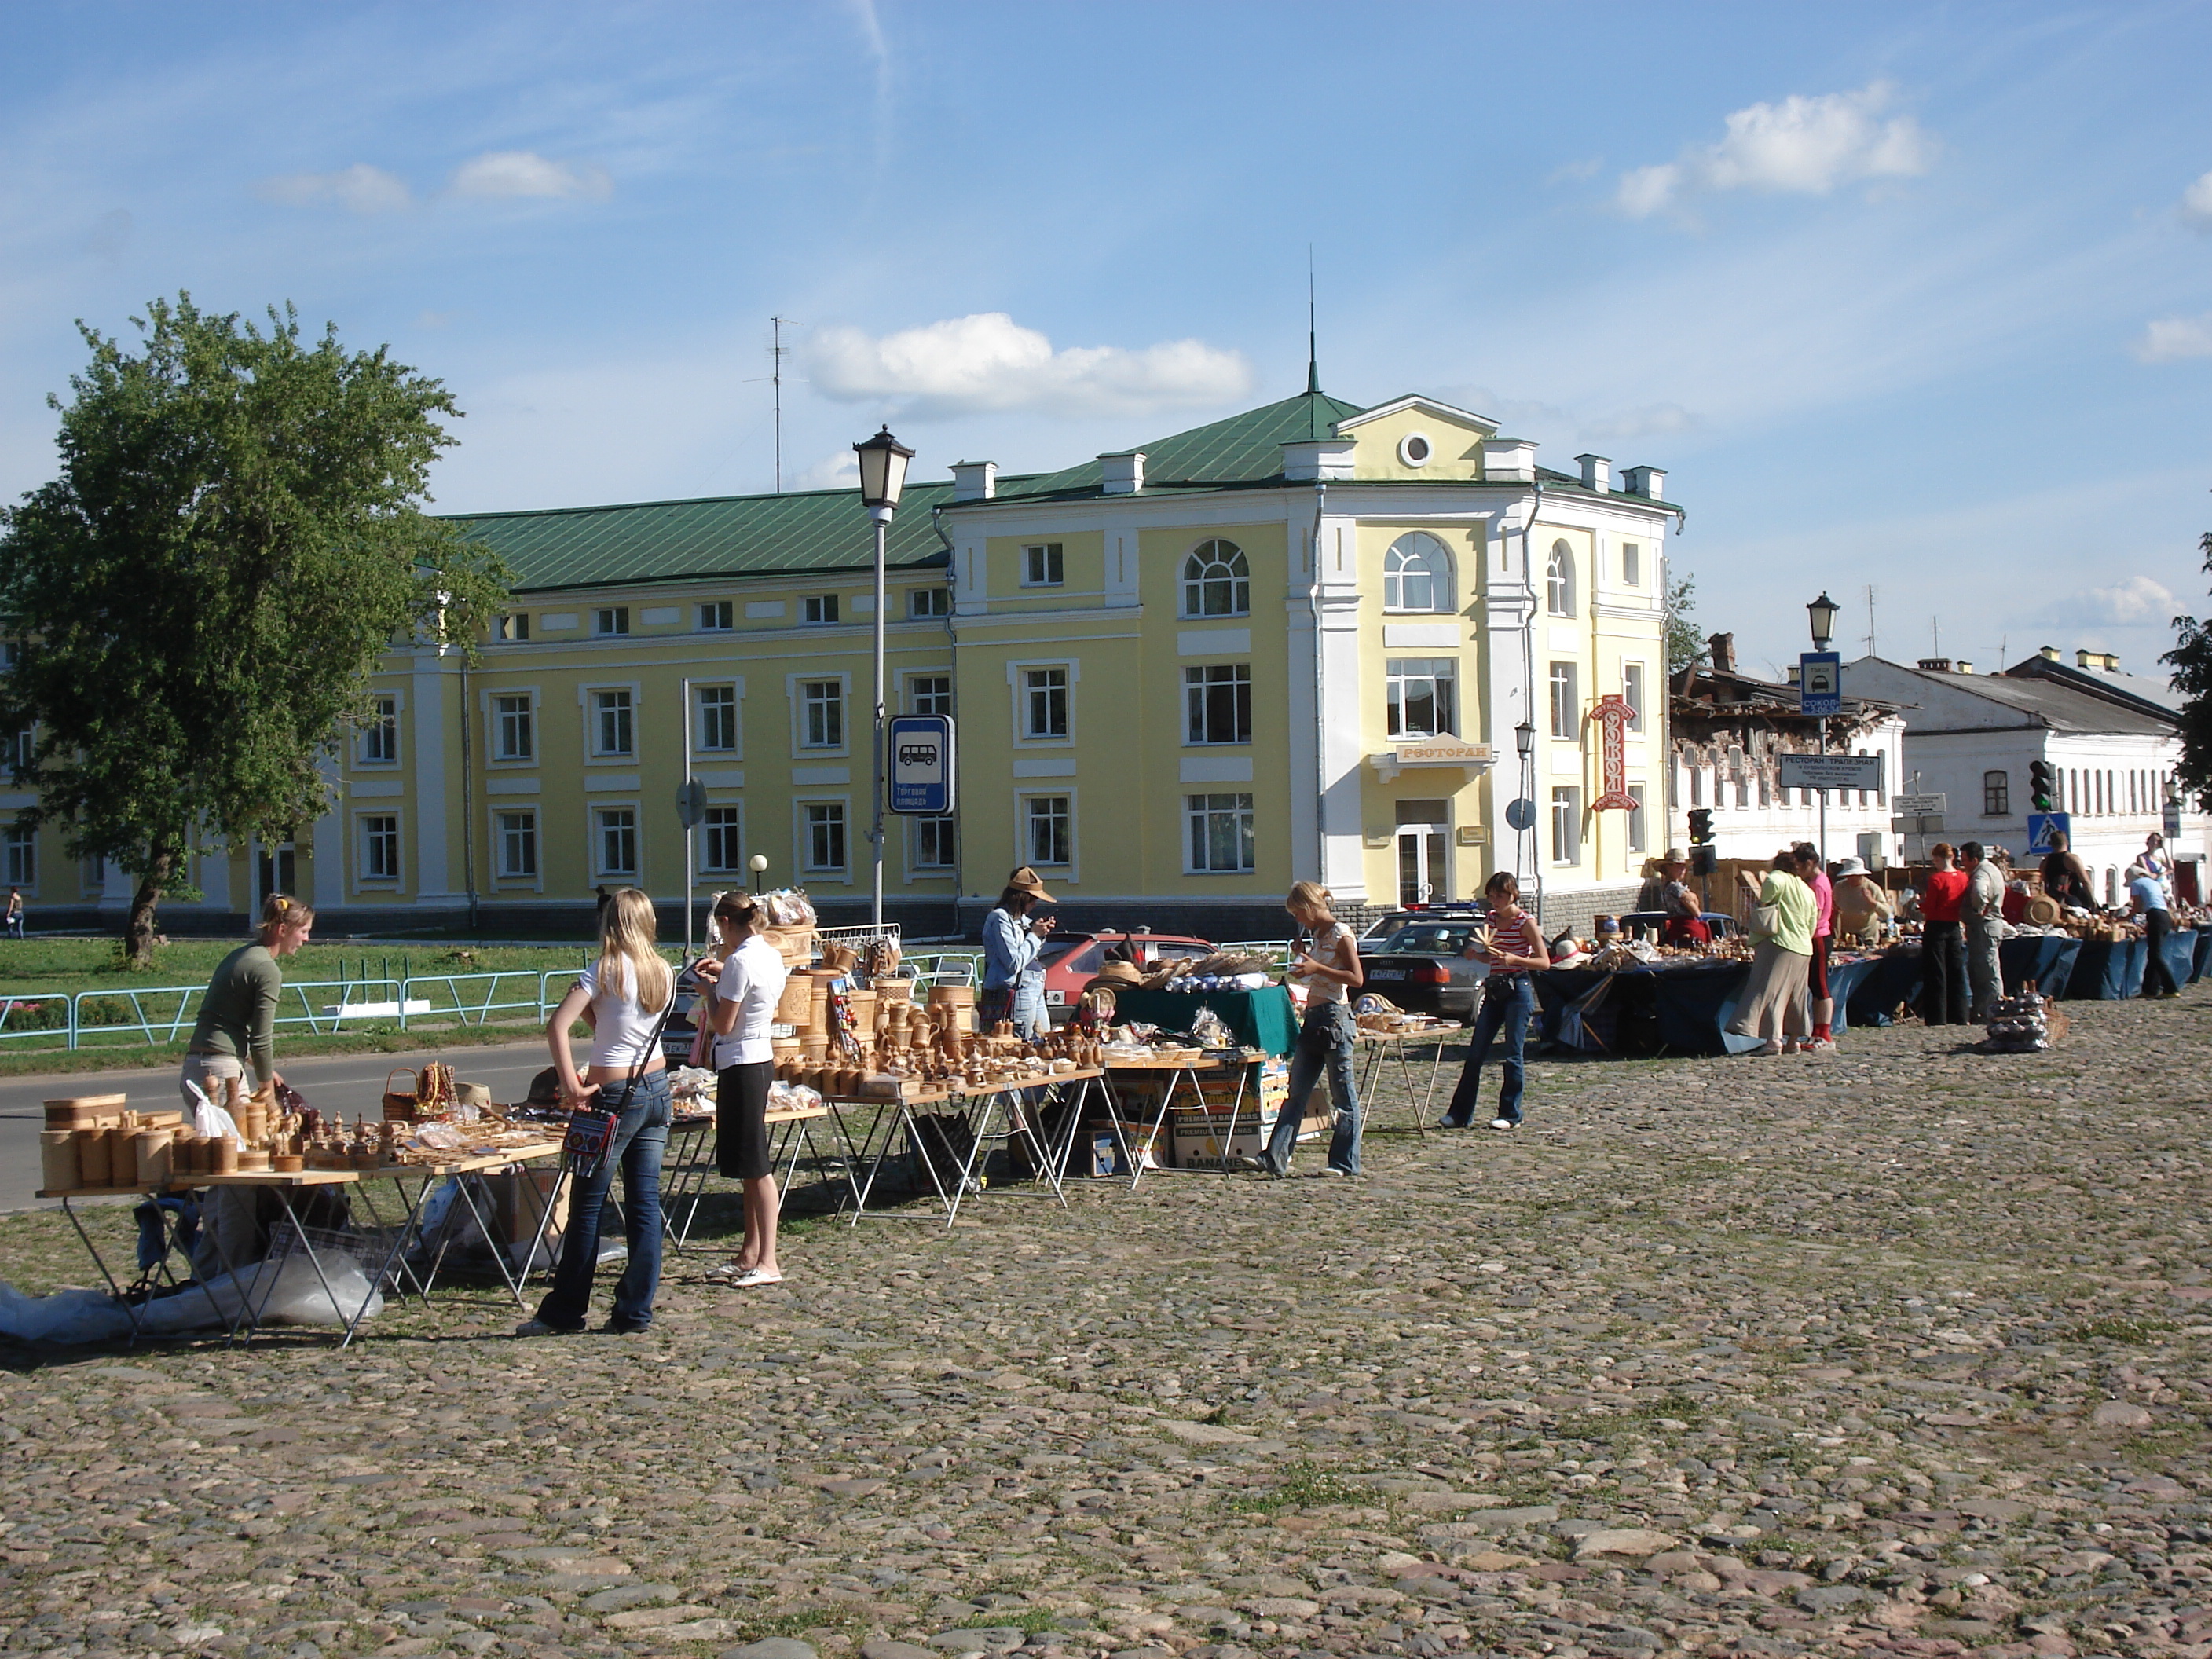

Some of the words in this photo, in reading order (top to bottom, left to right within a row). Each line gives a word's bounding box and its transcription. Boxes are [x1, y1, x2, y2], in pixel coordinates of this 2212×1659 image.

[1404, 747, 1488, 759] РЕСТОРАН
[1605, 711, 1622, 793] СОКОЛ
[897, 787, 927, 796] Торговая
